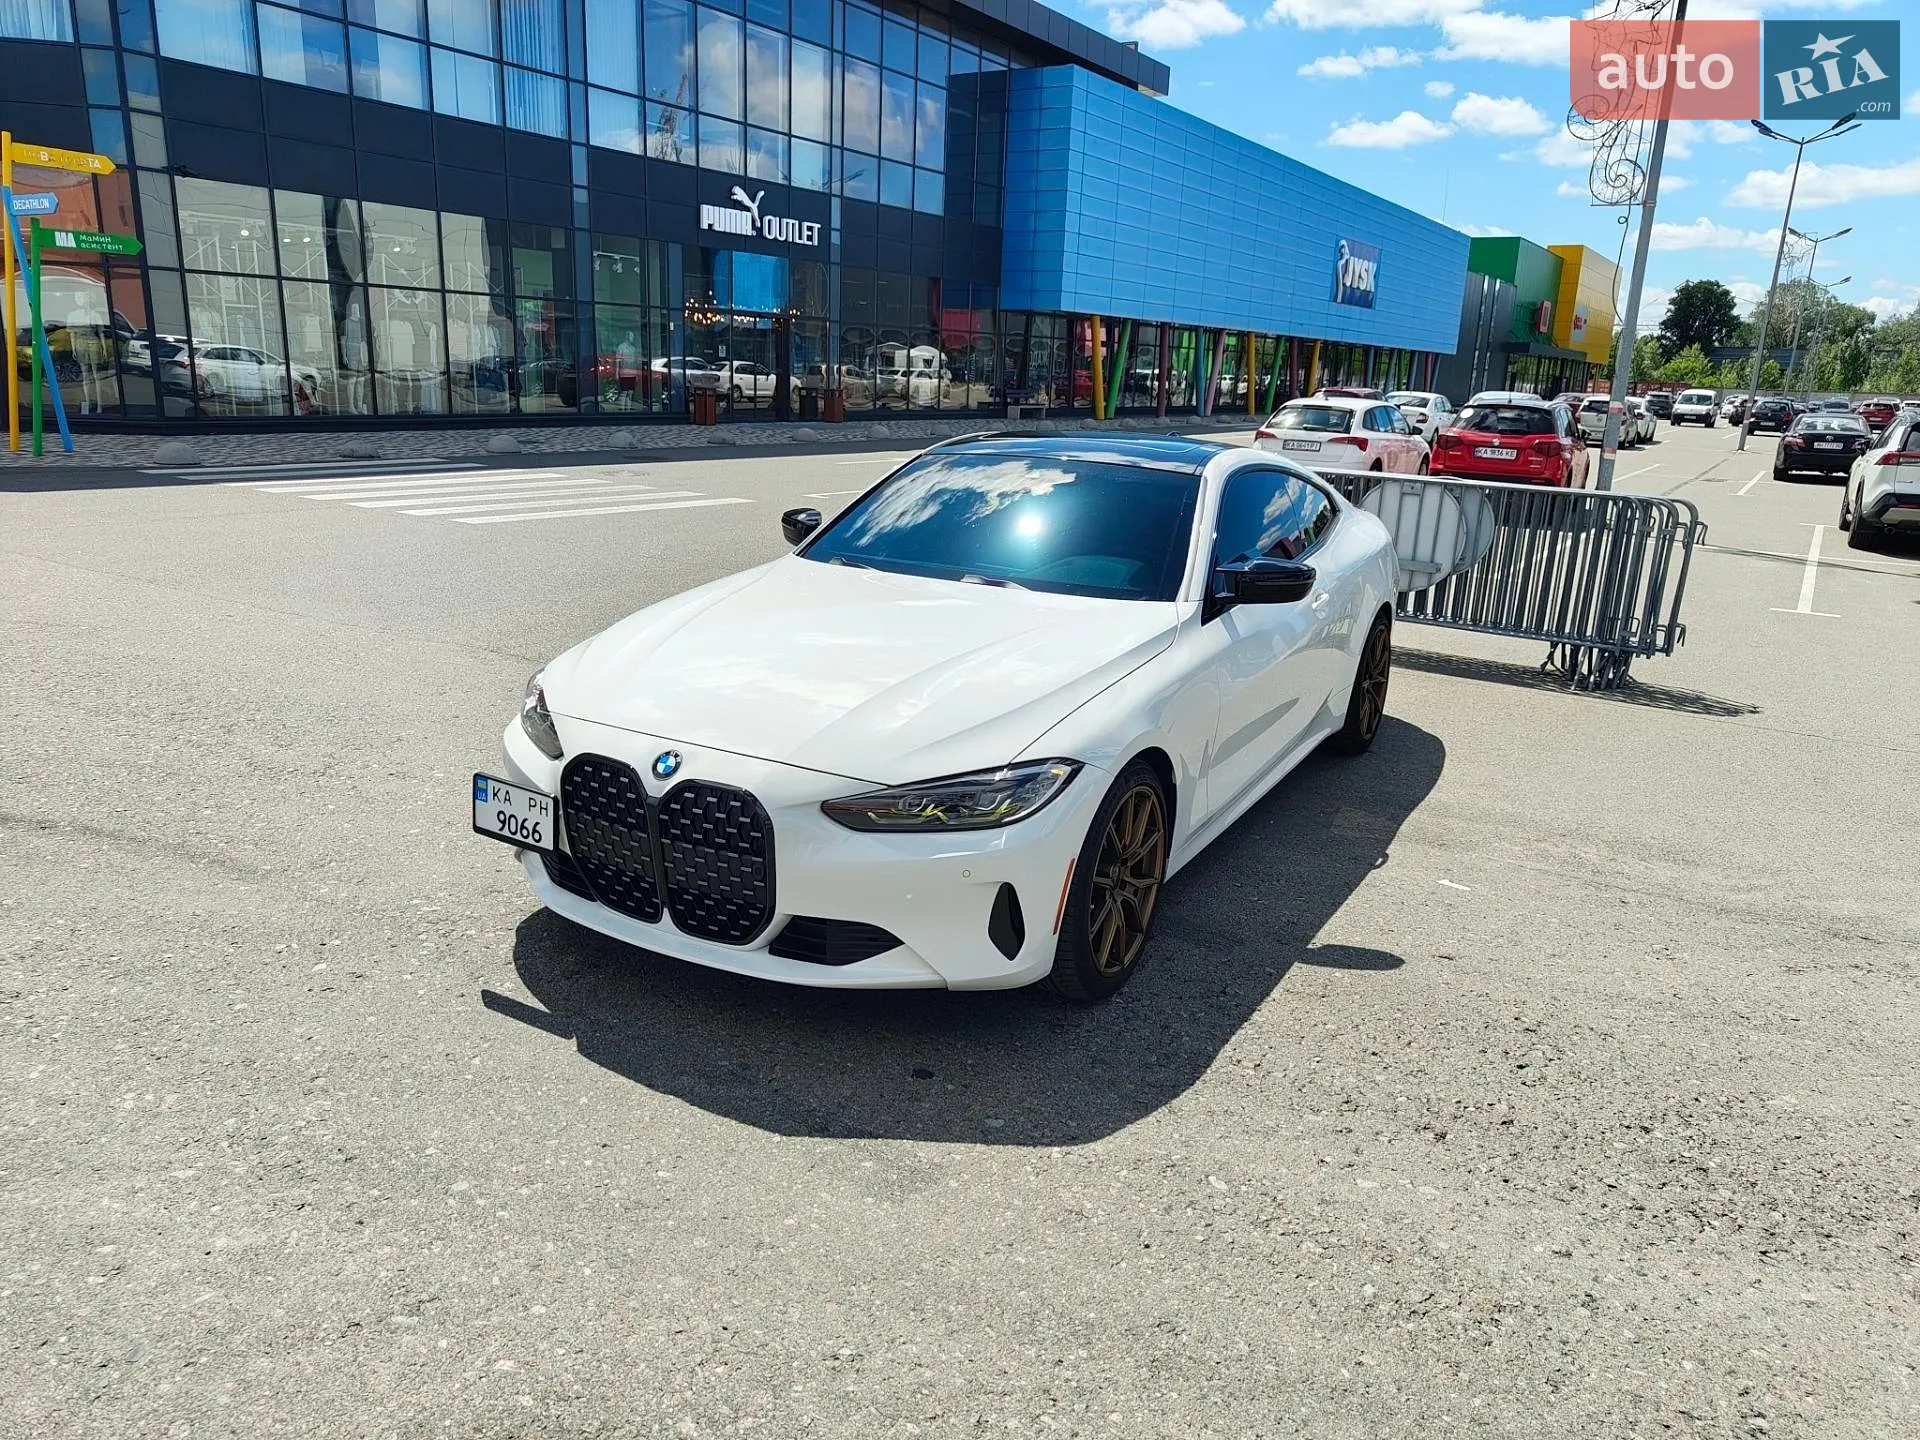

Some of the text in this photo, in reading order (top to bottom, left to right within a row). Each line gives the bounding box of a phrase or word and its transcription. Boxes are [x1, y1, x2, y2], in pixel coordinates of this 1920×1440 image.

[13, 198, 49, 210] DECATHLON
[700, 204, 821, 246] PUMA OUTLET
[1343, 255, 1377, 292] JYSK
[492, 786, 549, 817] KA PH
[497, 810, 543, 844] 9066
